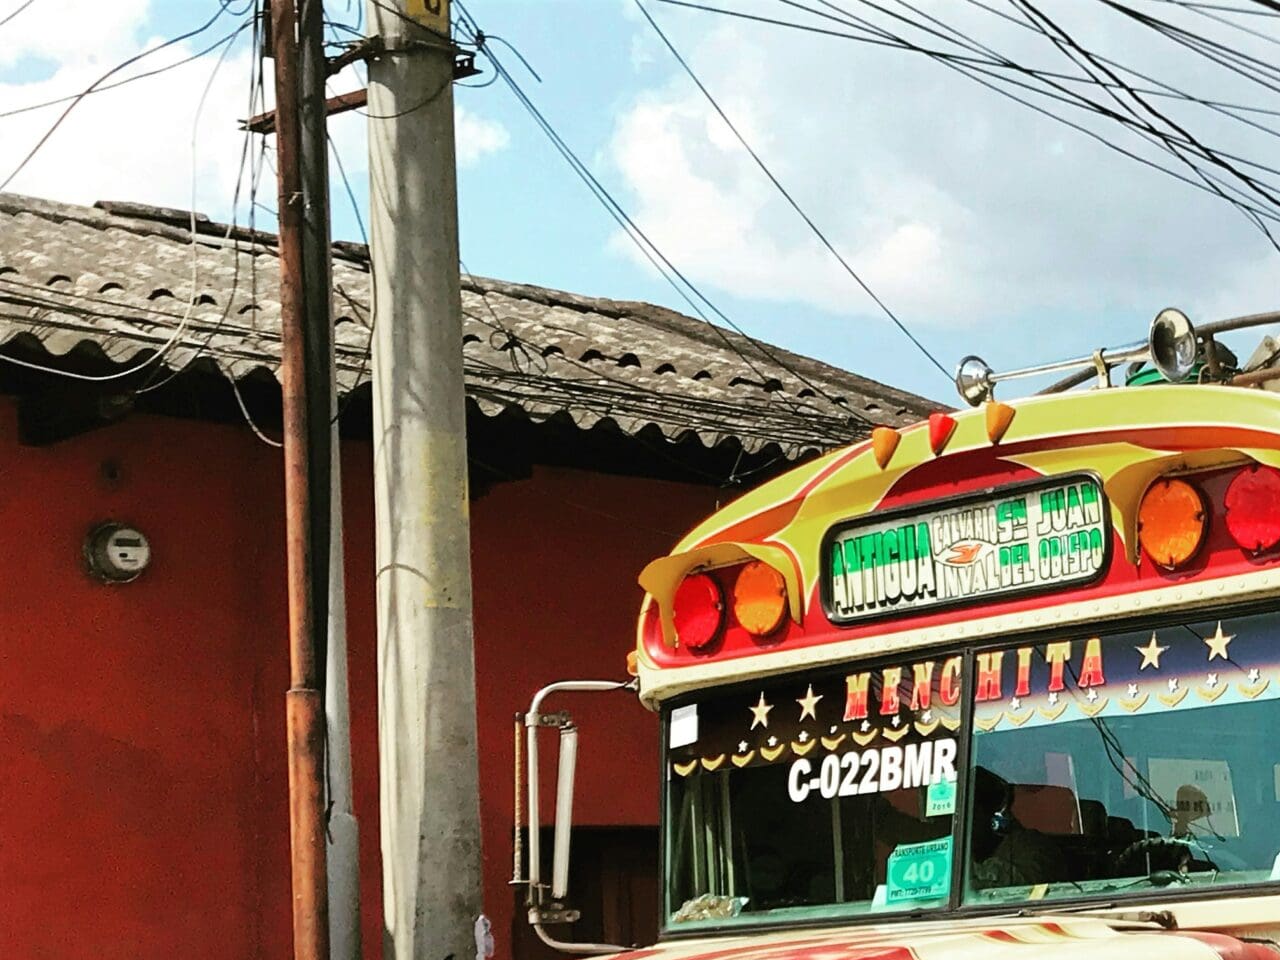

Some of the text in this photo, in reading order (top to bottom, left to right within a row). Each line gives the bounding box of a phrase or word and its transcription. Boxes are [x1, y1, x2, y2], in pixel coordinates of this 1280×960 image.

[932, 504, 998, 556] CALVARIO
[1037, 482, 1101, 537] JUAN
[832, 521, 938, 615] ANTIGUA
[998, 528, 1103, 588] DEL OBISPO
[842, 638, 1105, 723] MENCHITA
[787, 737, 958, 803] C-022BMR
[902, 859, 935, 884] 40
